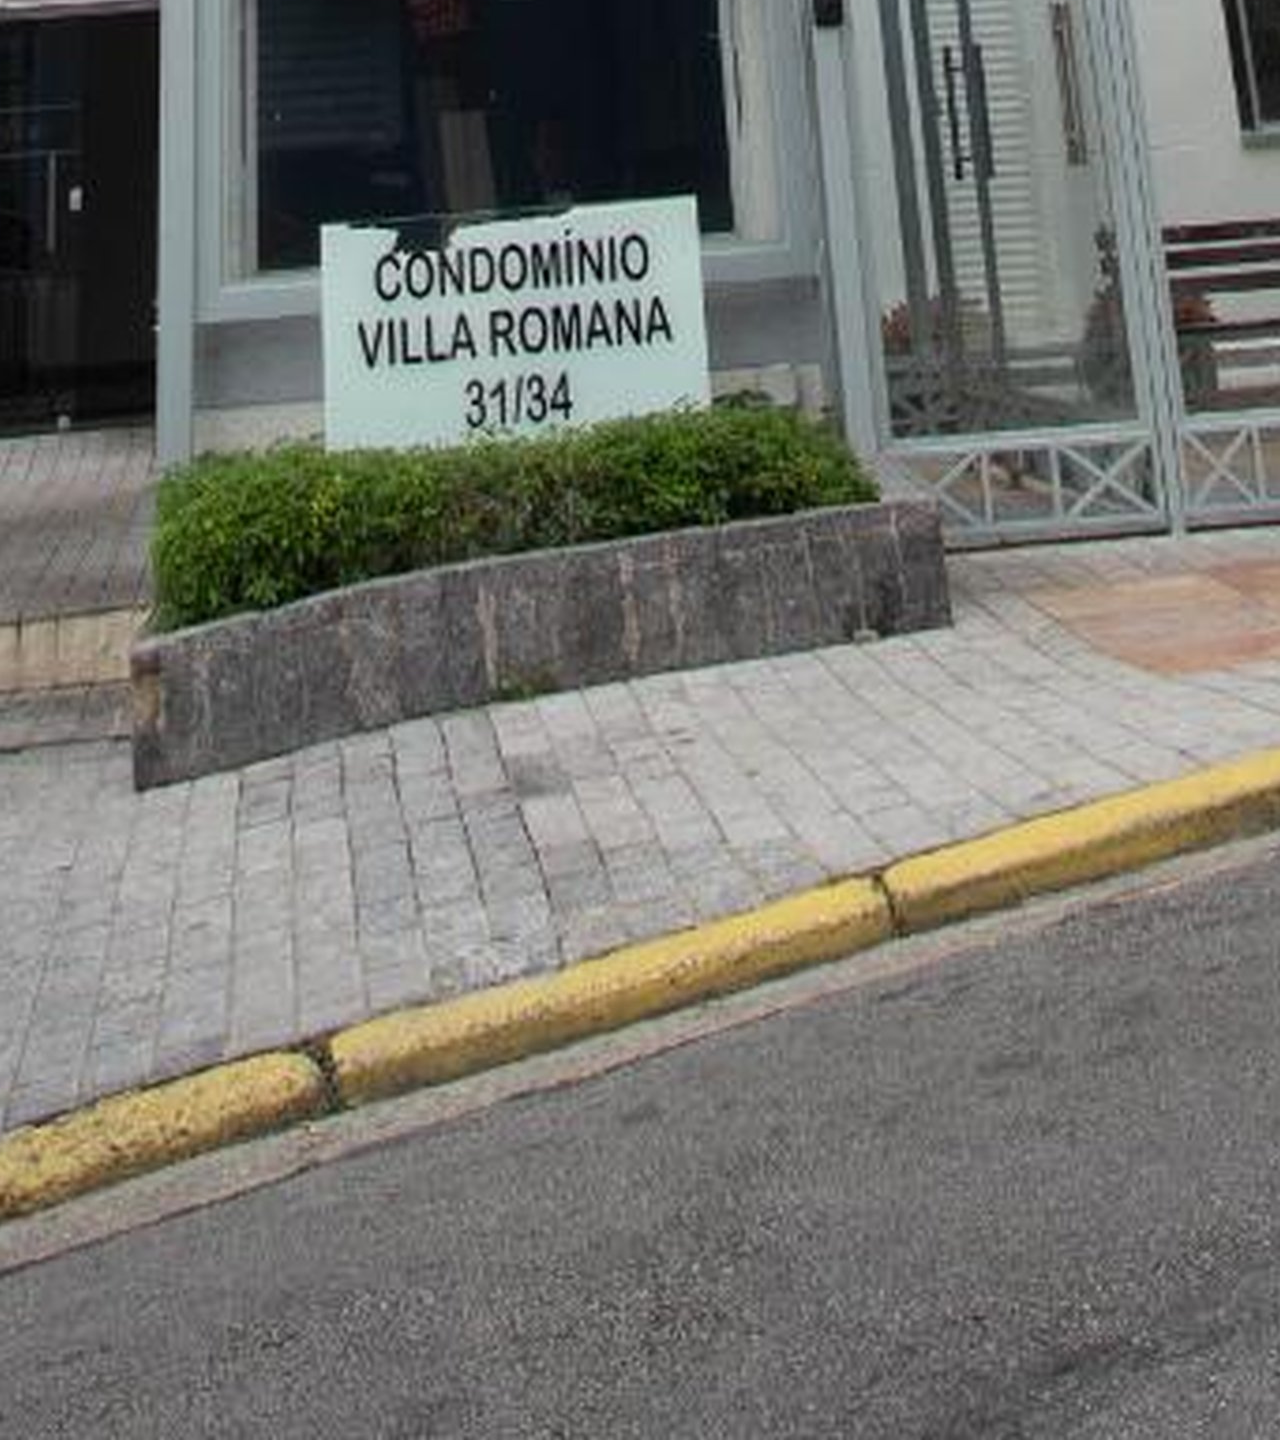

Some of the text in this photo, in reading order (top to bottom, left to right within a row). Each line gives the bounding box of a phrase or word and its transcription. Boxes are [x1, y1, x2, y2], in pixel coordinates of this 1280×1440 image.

[375, 229, 649, 302] CONDOMÍNIO
[357, 296, 673, 369] VILLA ROMANA
[464, 371, 573, 429] 31/34
